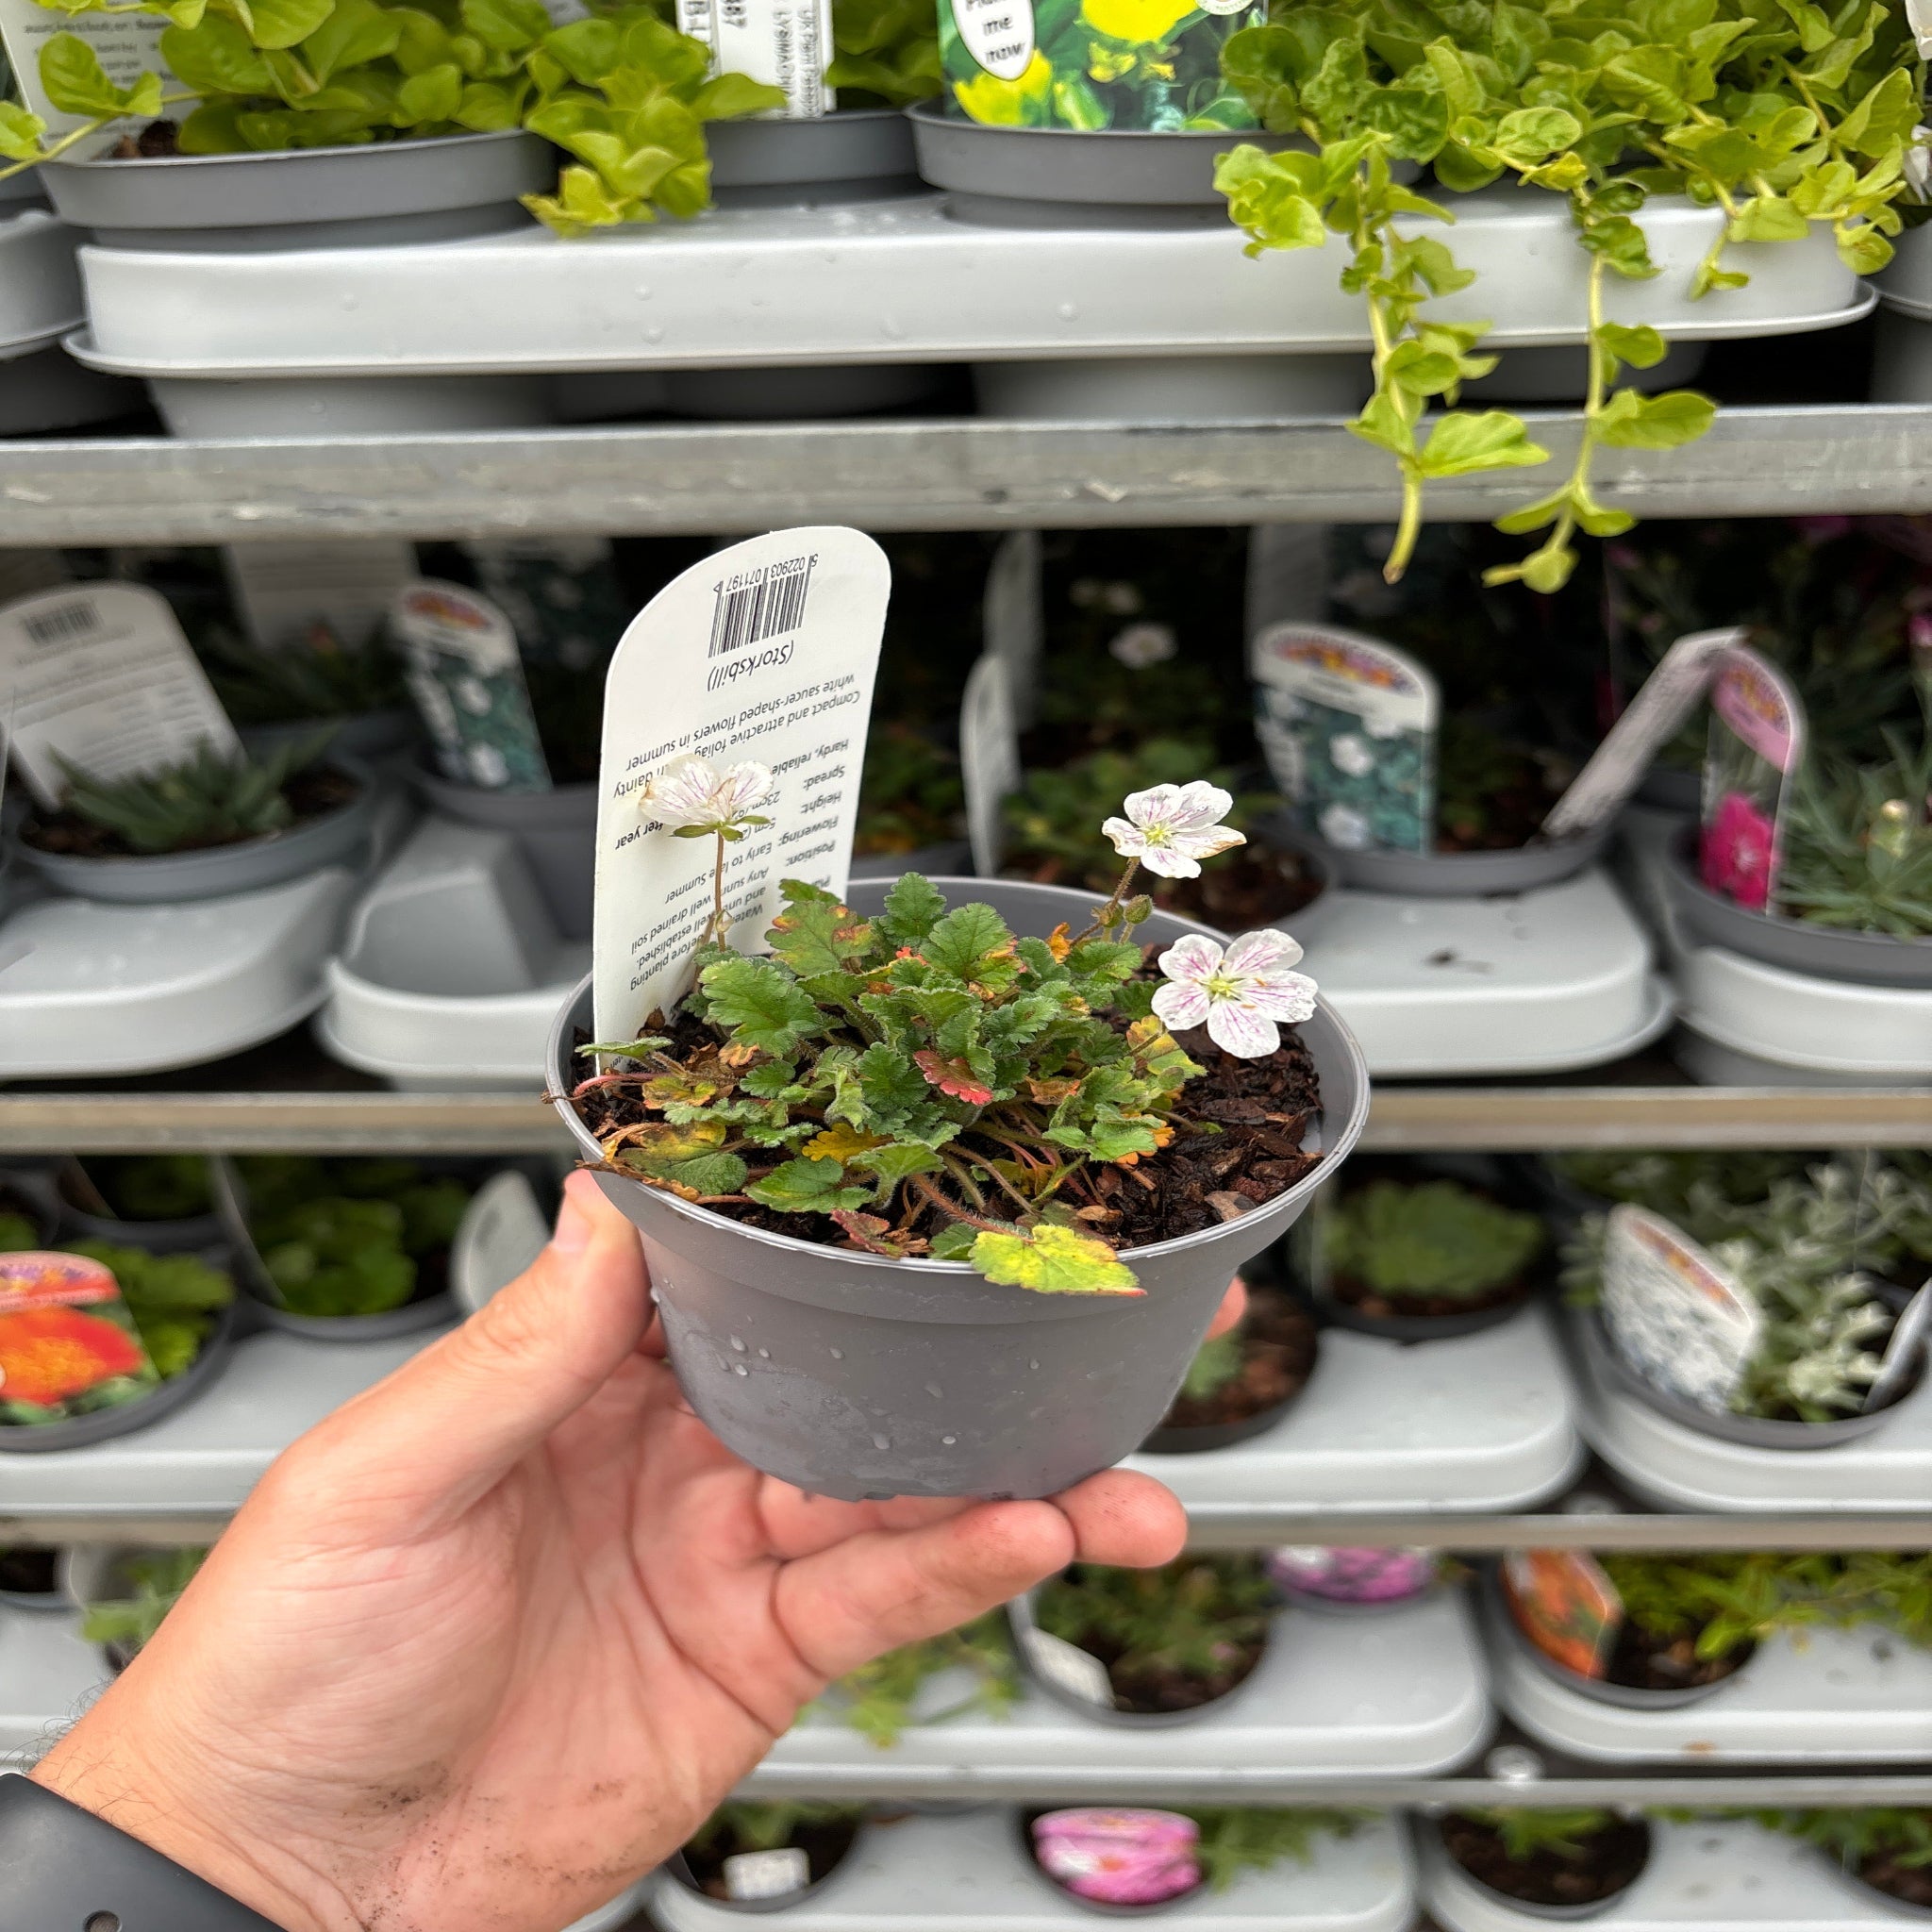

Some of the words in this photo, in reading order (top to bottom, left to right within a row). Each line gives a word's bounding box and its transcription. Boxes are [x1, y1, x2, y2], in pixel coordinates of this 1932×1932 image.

[770, 557, 806, 578] 022903
[726, 568, 762, 591] 071197
[708, 640, 794, 691] (Storksbill)
[822, 675, 855, 691] white
[739, 684, 821, 726] saucer-shaped
[811, 691, 860, 716] Compact
[693, 715, 736, 742] flowers
[787, 708, 809, 727] and
[678, 734, 691, 748] in
[730, 716, 785, 745] attractive
[625, 740, 677, 772] summer
[693, 738, 727, 759] foliag
[772, 752, 812, 776] reliable
[613, 771, 654, 798] dainty
[803, 764, 846, 791] Spread:
[801, 791, 842, 814] Height:
[615, 824, 641, 850] year
[642, 819, 664, 836] fter
[778, 815, 839, 846] Flowering:
[731, 856, 743, 867] to
[745, 841, 773, 861] Early
[785, 840, 836, 867] Position:
[708, 860, 729, 878] lae
[746, 866, 770, 884] Any
[665, 873, 707, 904] Summer
[744, 886, 766, 904] and
[690, 894, 712, 917] well
[733, 904, 763, 924] Wate
[650, 907, 688, 942] drained
[631, 934, 649, 955] soil
[636, 924, 692, 971] established.
[630, 957, 670, 991] planting
